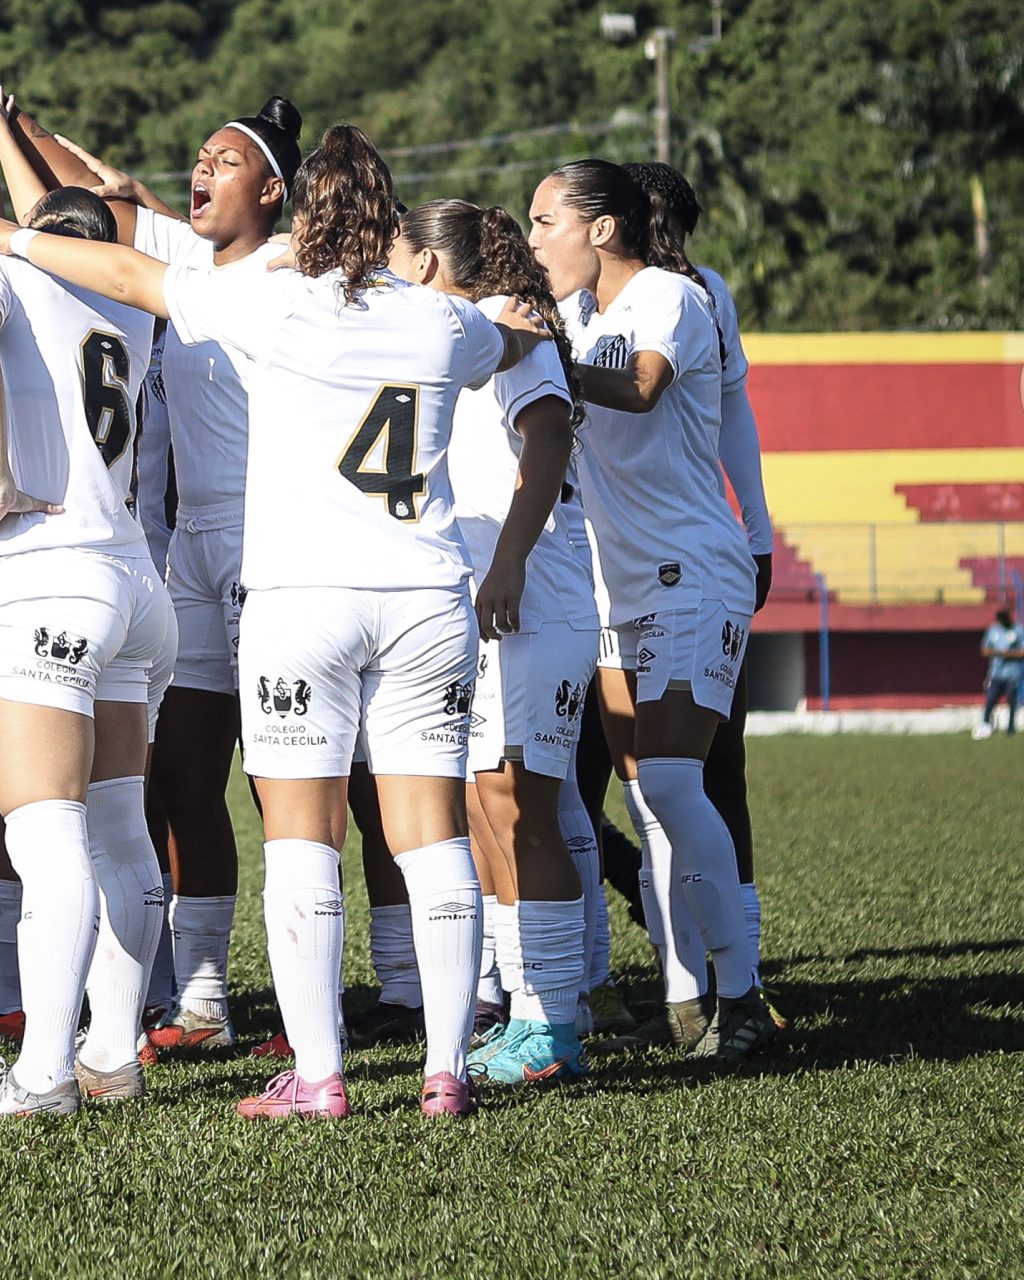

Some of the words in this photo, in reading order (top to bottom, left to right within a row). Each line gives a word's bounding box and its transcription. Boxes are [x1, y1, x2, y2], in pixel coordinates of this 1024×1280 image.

[79, 328, 131, 471] 6
[334, 382, 426, 524] 4
[12, 666, 52, 681] SANTA
[421, 732, 456, 745] SANTA
[429, 913, 477, 921] umbro
